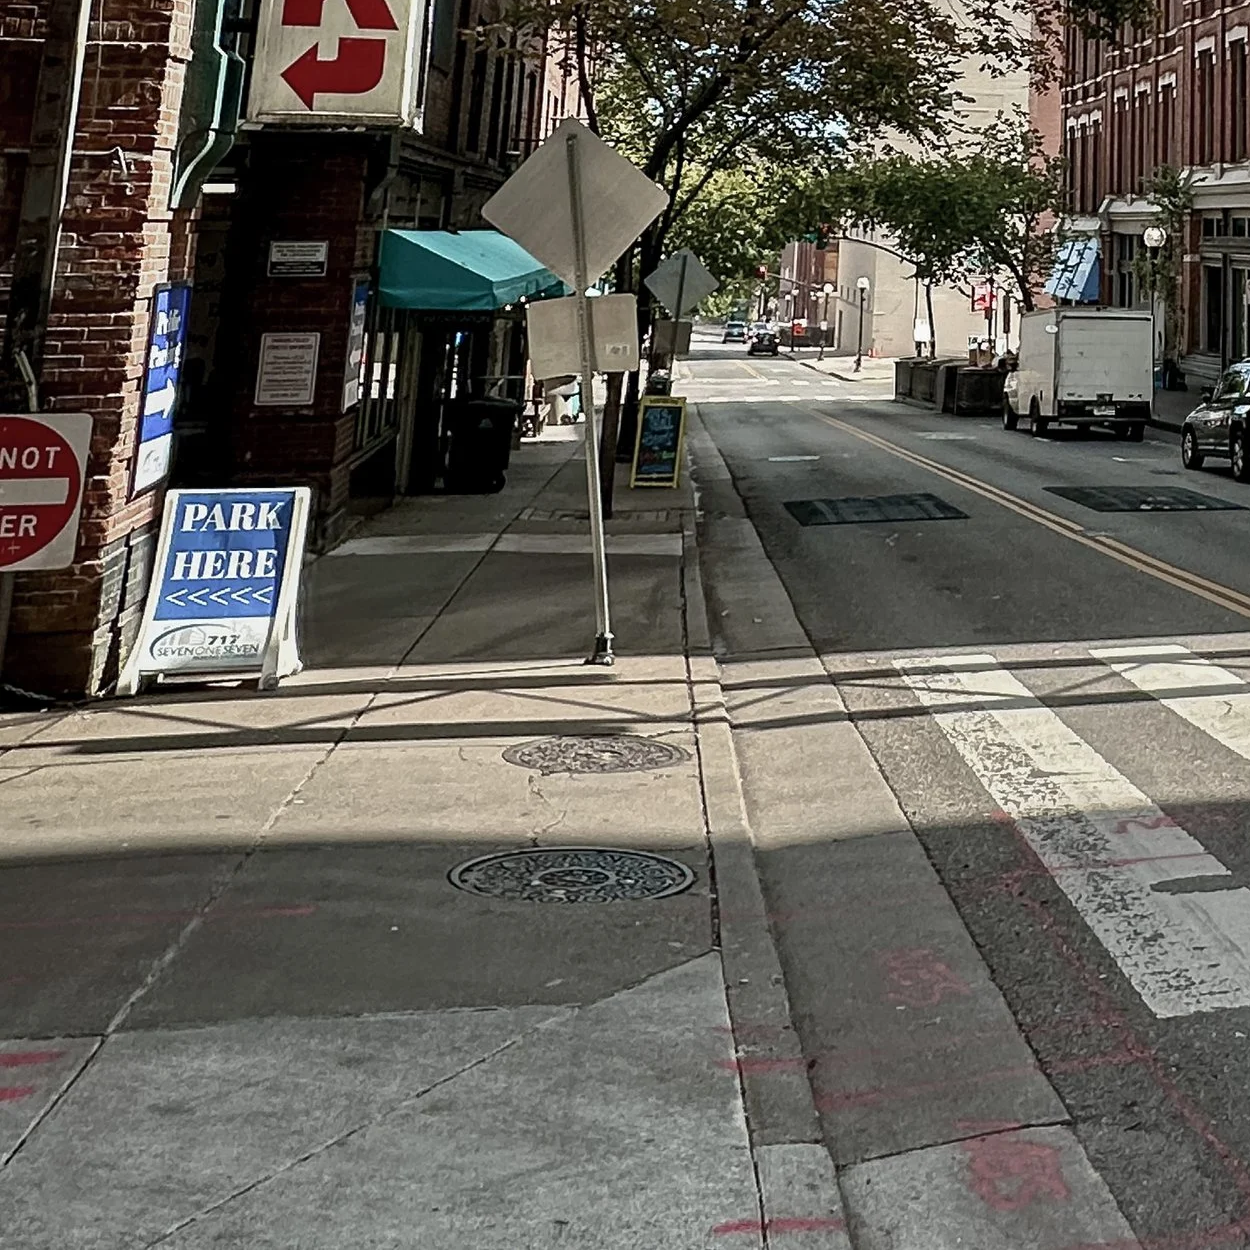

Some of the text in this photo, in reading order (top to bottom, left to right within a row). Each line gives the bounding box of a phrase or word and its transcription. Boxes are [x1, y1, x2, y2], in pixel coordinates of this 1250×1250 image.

[0, 446, 61, 470] NOT
[180, 501, 285, 532] PARK
[170, 548, 278, 581] HERE
[207, 634, 240, 646] 717
